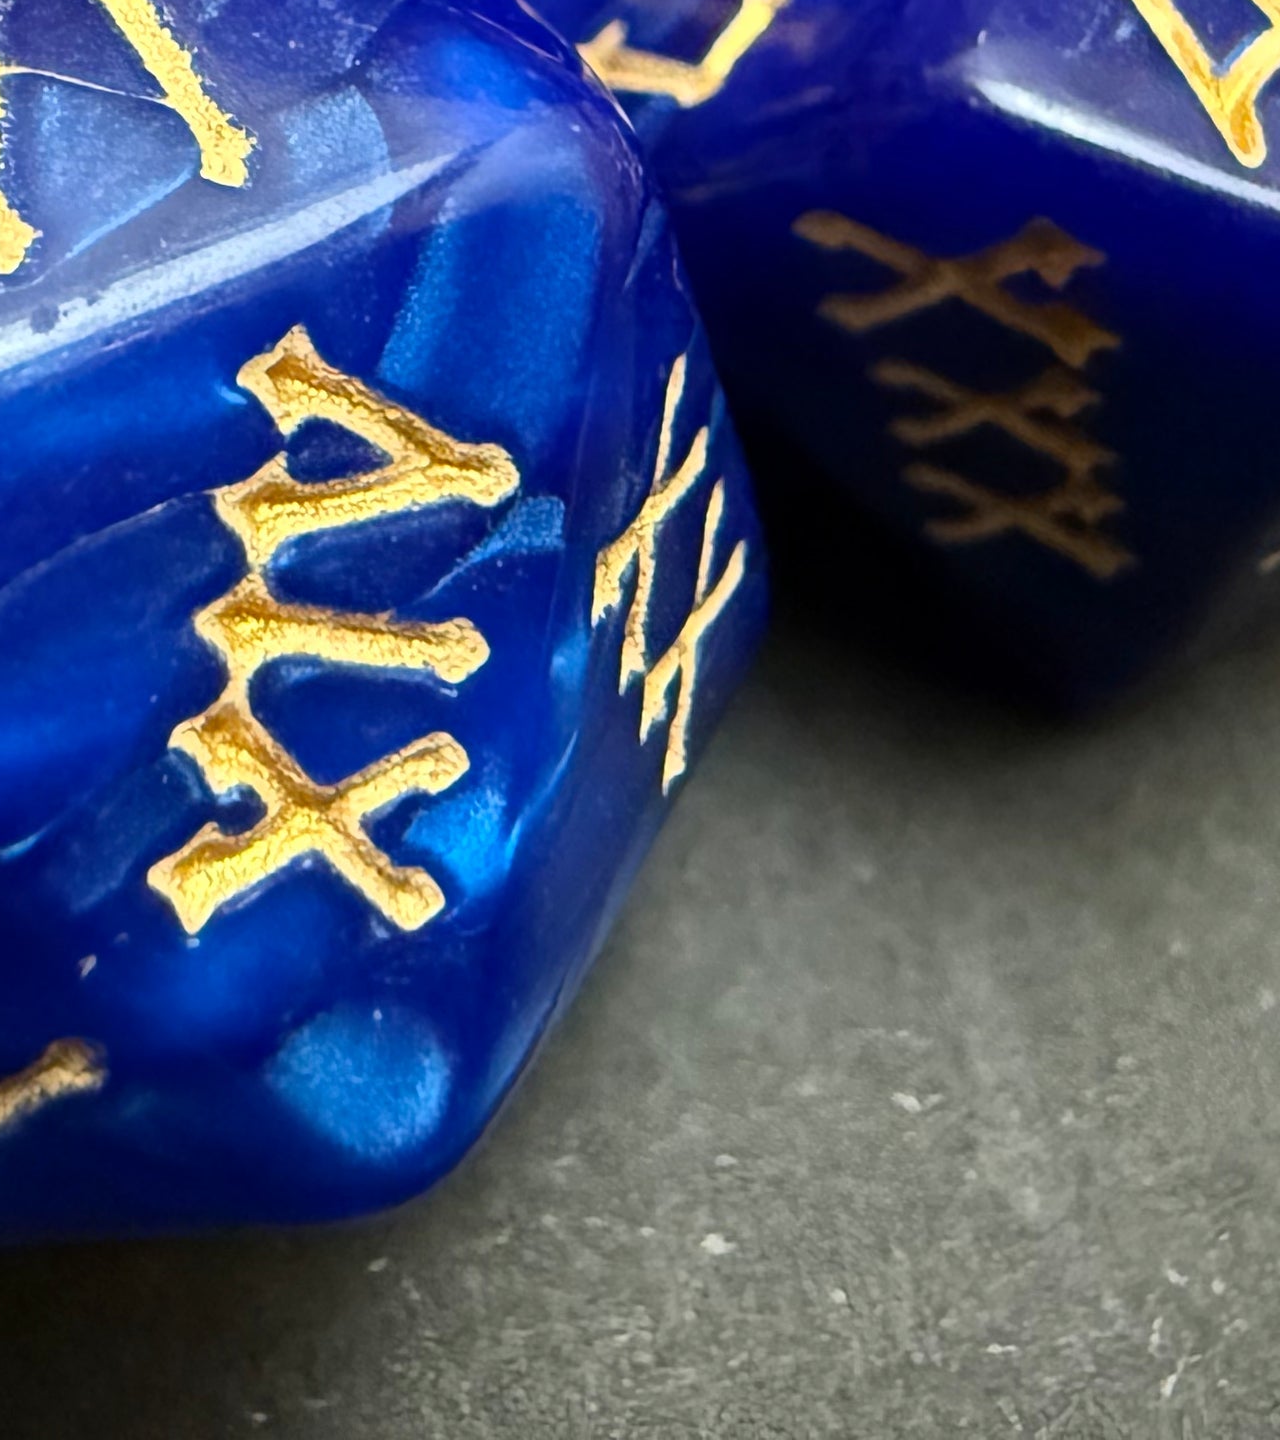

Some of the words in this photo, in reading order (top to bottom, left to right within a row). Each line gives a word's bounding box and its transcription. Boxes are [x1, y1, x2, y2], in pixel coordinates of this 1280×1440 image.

[591, 352, 746, 797] XX
[789, 207, 1142, 586] XXX
[147, 324, 519, 933] XIV
